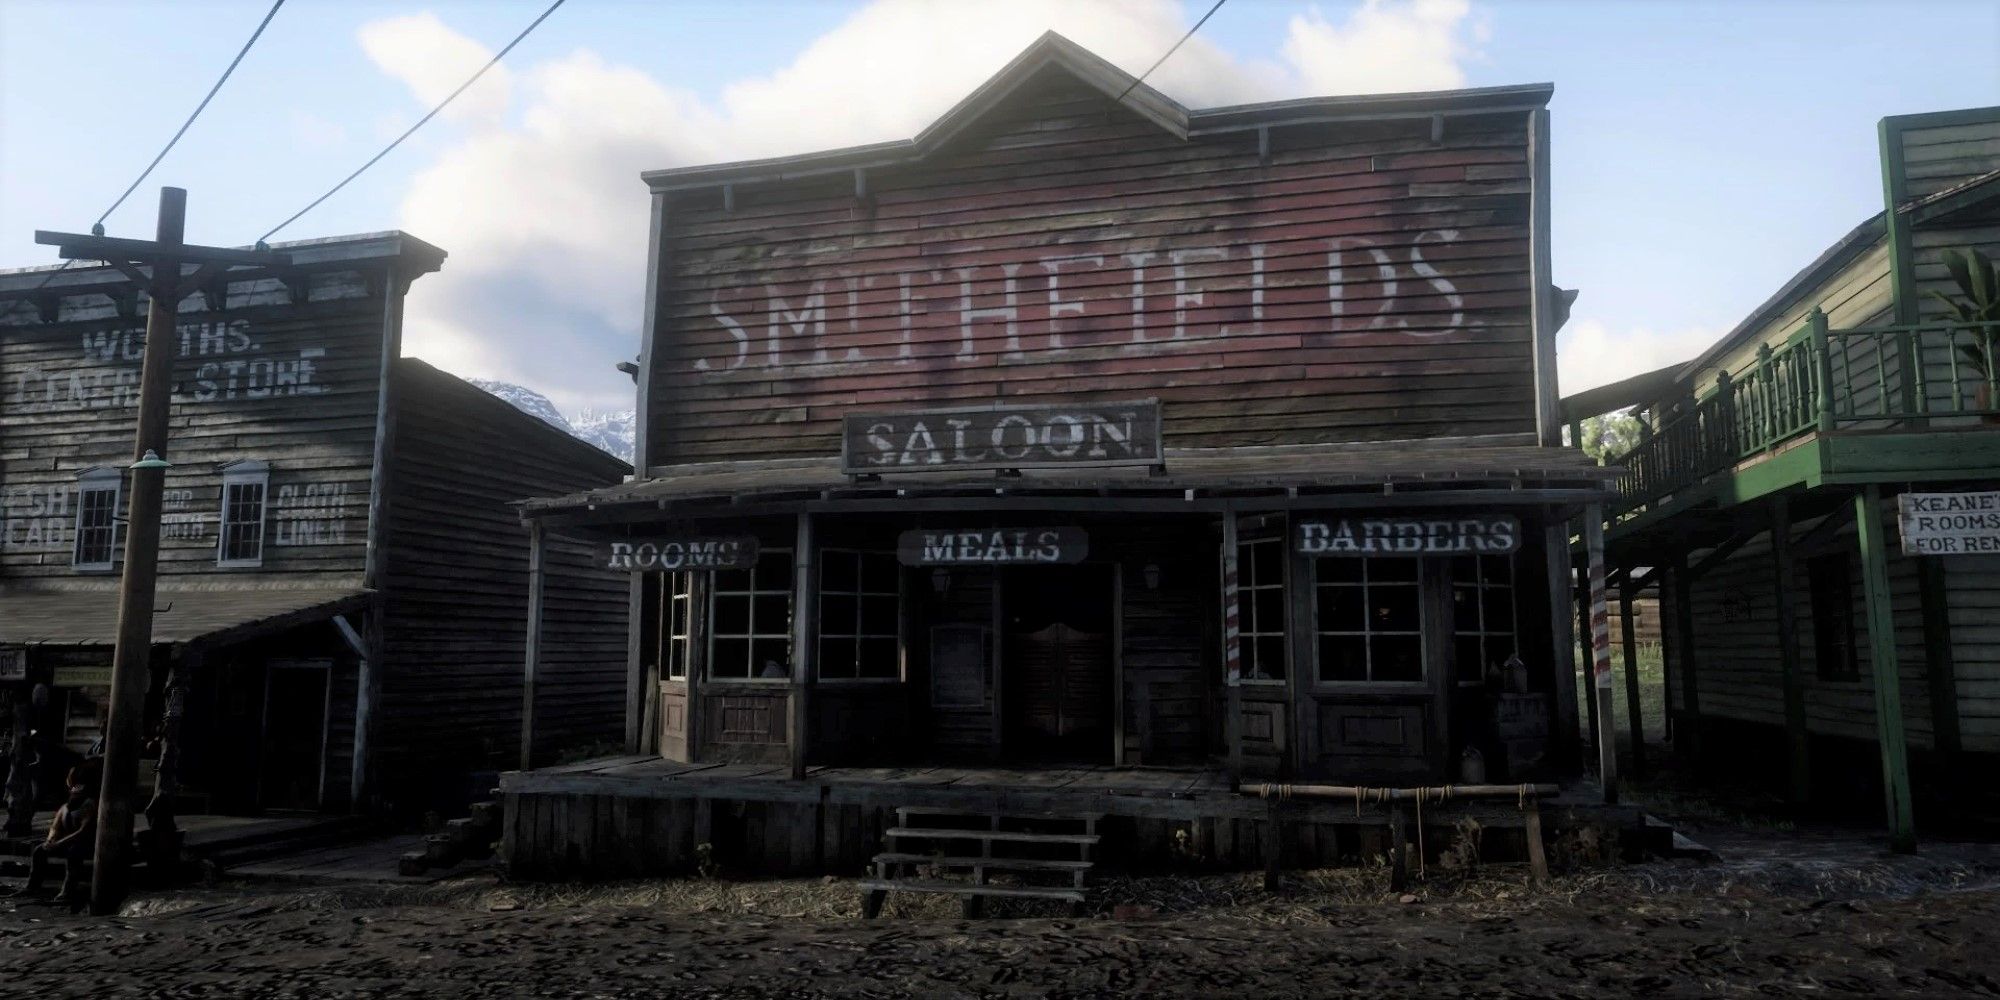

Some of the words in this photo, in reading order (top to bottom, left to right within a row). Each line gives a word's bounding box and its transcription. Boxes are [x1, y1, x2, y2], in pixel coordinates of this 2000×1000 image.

[82, 319, 260, 360] WOTHS.
[276, 483, 347, 516] CLOTH
[275, 518, 346, 546] LINEN
[1302, 520, 1513, 551] BARBERS
[1919, 513, 2000, 531] ROOMS
[608, 542, 739, 568] ROOMS
[922, 531, 1060, 561] MEALS
[1917, 537, 1957, 552] FOR
